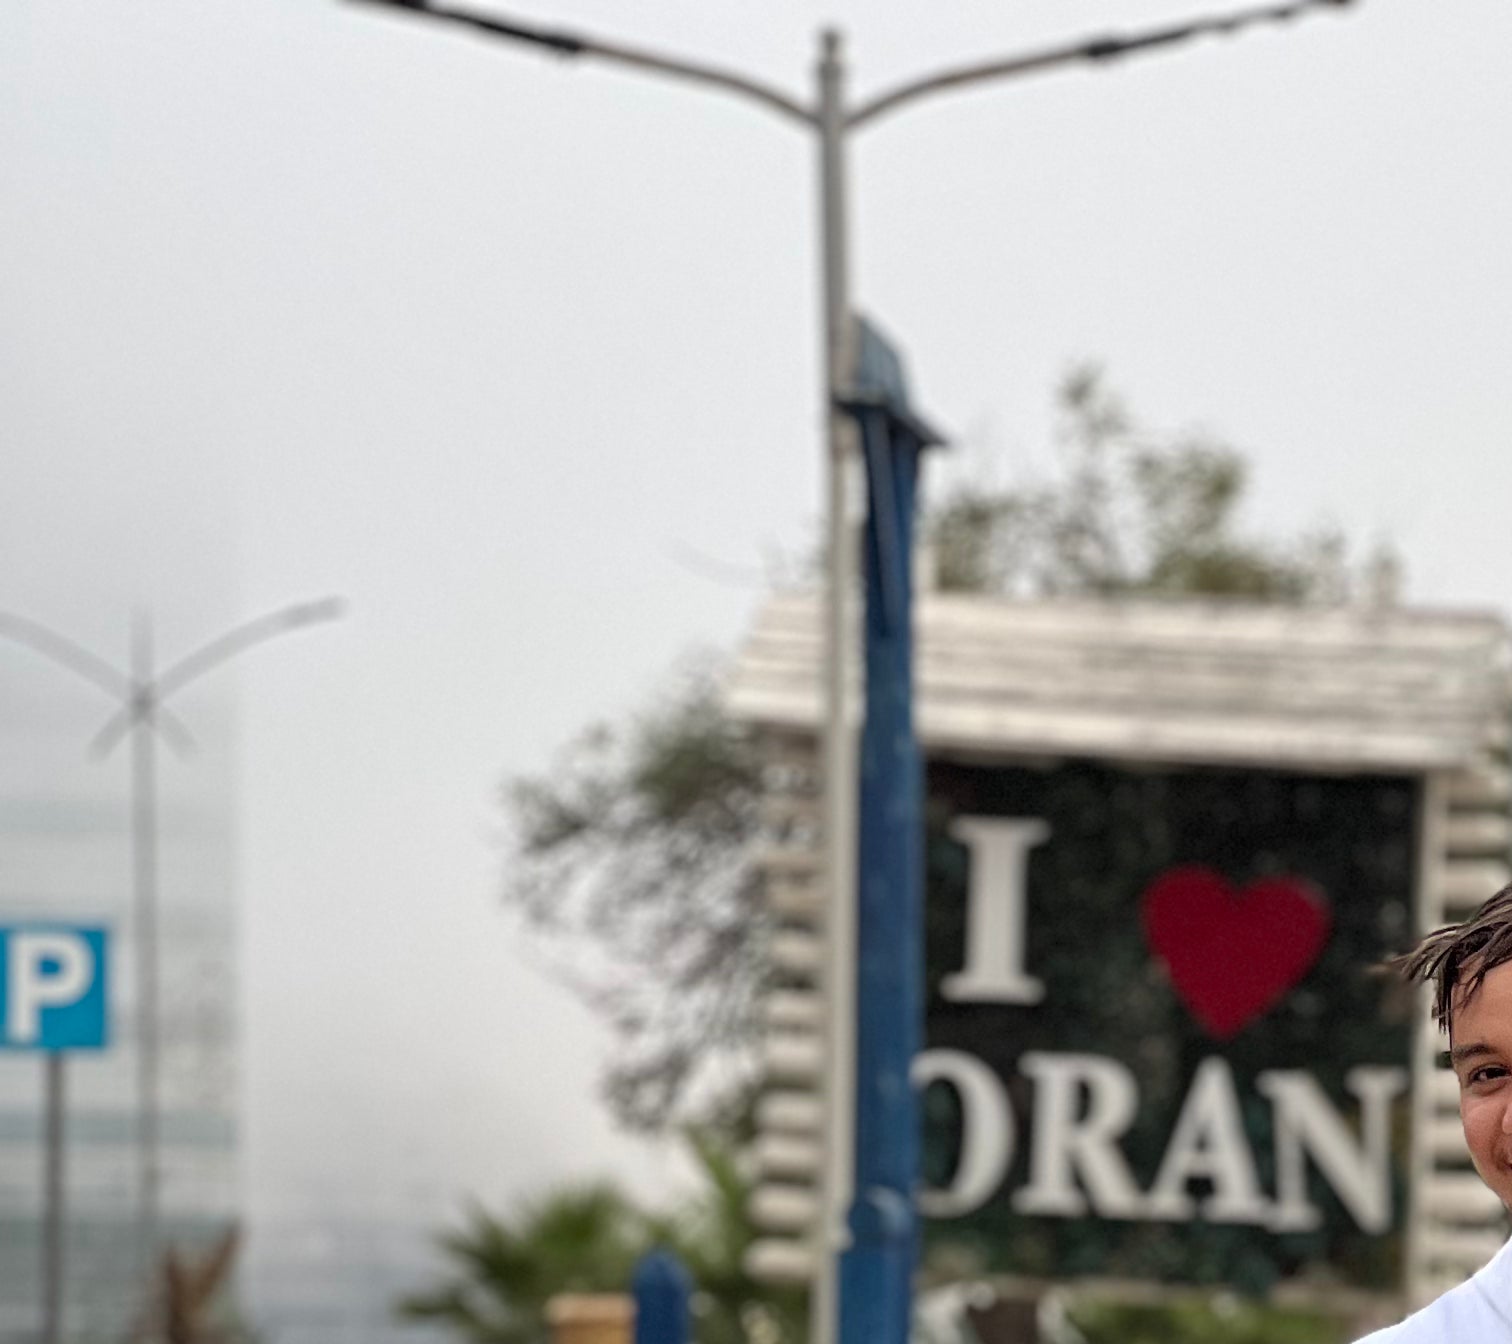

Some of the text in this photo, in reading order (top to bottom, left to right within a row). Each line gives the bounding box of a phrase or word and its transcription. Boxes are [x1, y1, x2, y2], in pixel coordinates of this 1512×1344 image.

[7, 934, 95, 1040] P
[940, 815, 1051, 1004] I
[909, 1048, 1408, 1235] ORAN
